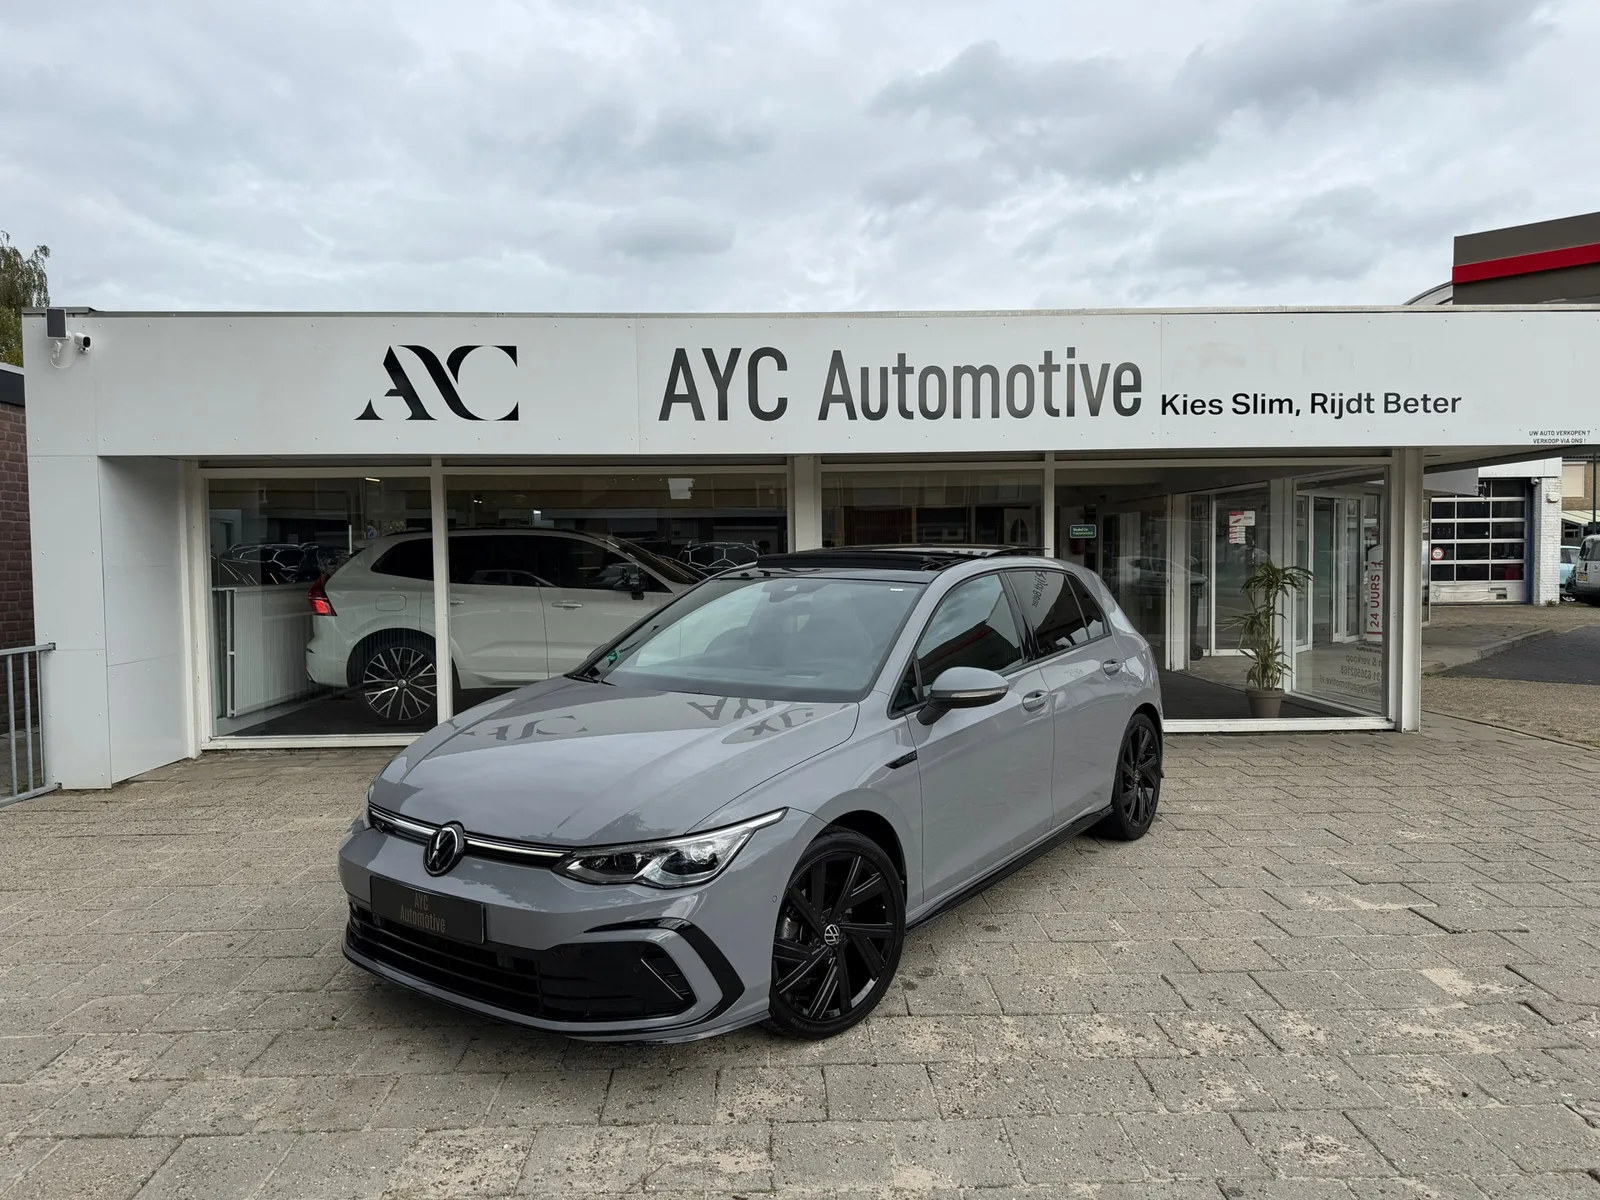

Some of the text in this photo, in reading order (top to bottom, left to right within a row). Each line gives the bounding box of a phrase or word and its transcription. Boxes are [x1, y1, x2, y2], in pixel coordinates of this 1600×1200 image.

[658, 346, 1142, 422] AYC Automotive
[1160, 392, 1462, 420] Kies Slim, Rijdt Beter
[1370, 574, 1380, 628] 24 UURS
[414, 892, 429, 911] AYC
[400, 904, 446, 933] Automotive
